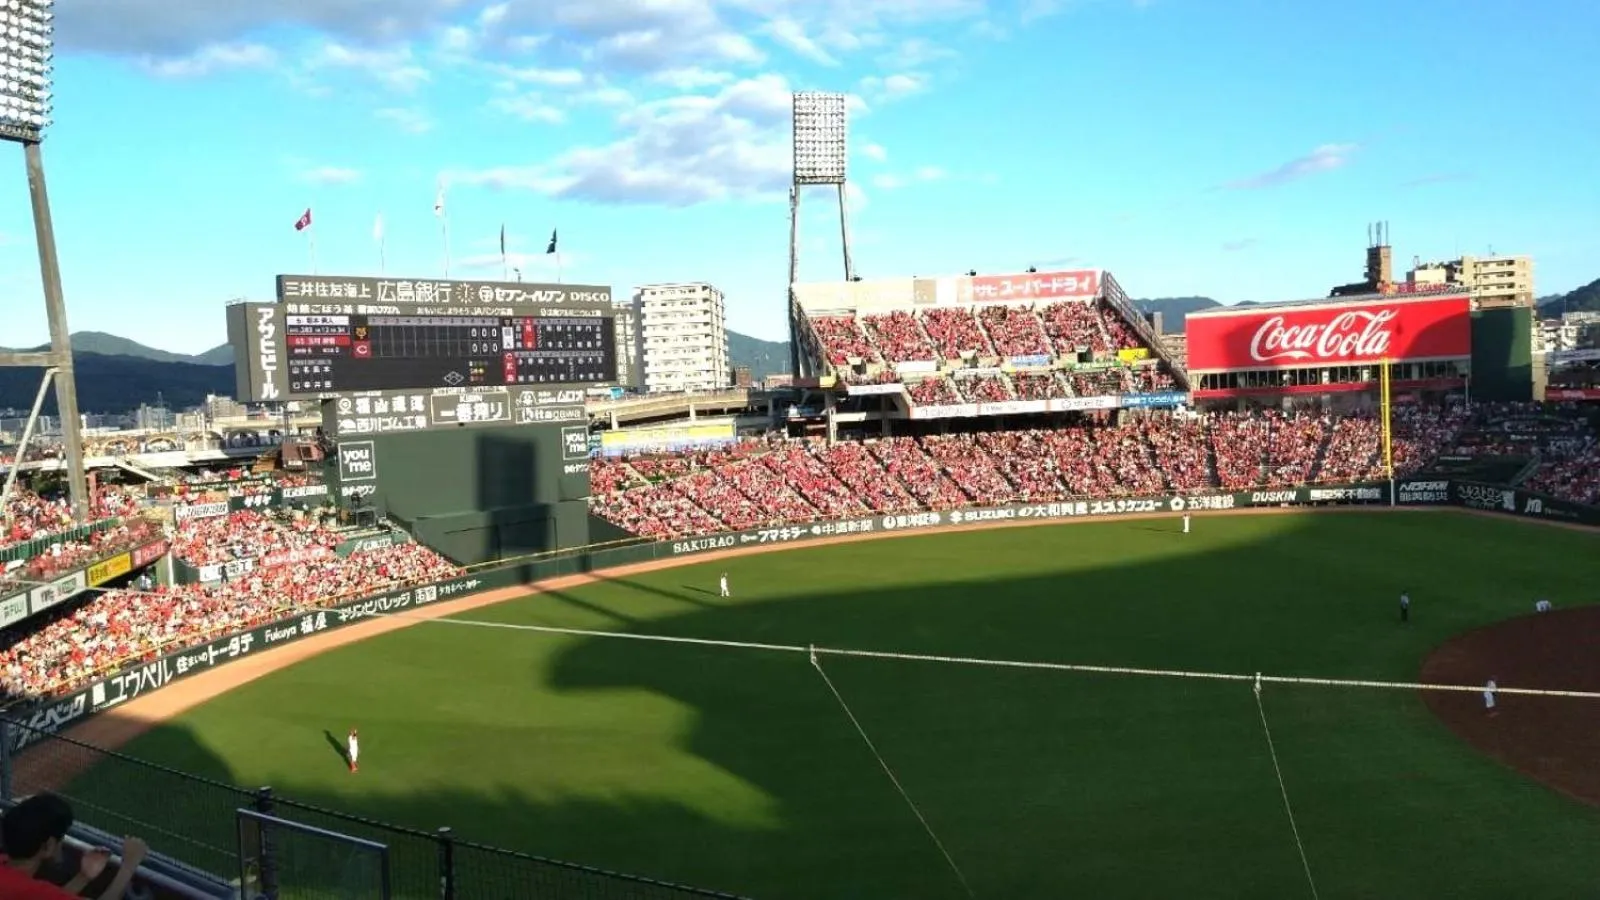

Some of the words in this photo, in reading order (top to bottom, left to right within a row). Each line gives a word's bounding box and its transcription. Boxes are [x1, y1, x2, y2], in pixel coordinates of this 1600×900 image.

[285, 281, 372, 298] 三井住友海上
[377, 281, 451, 303] 広島銀行
[570, 292, 609, 302] DISCO
[1249, 310, 1398, 363] Coca-Cola
[257, 308, 279, 399] アサヒビール
[439, 402, 503, 422] 一番搾り
[565, 433, 585, 446] you
[569, 443, 587, 453] me
[343, 448, 370, 464] you
[349, 460, 372, 473] me
[1251, 490, 1297, 502] DUSKIN
[964, 509, 1015, 521] SUZUKI
[673, 535, 735, 553] SAKURAO
[301, 611, 328, 634] 福屋
[265, 625, 297, 643] Fukuya
[108, 658, 173, 706] ユウベル
